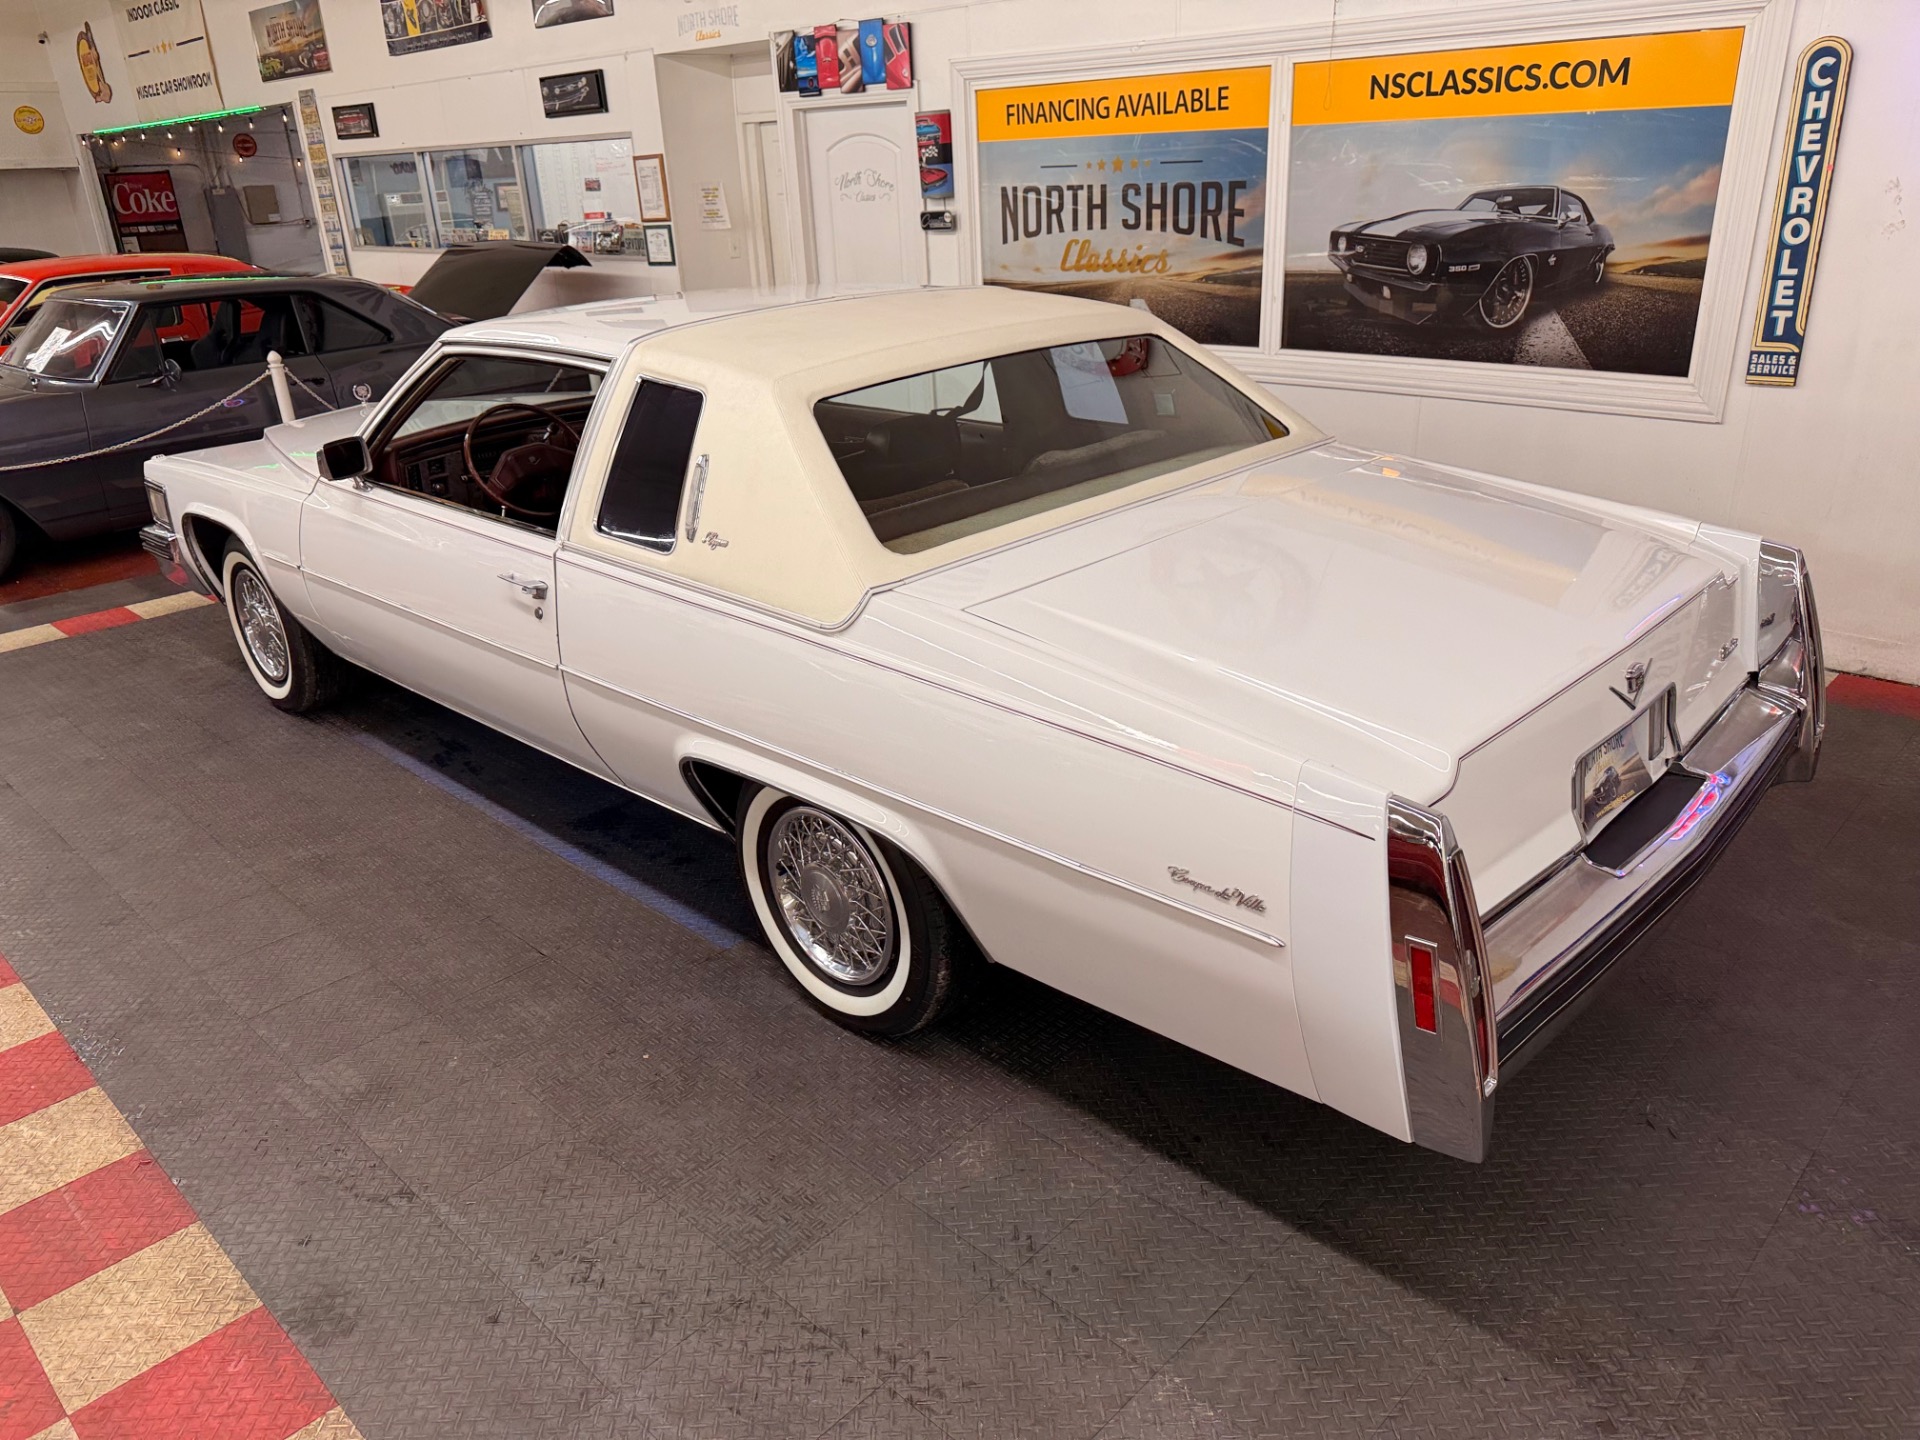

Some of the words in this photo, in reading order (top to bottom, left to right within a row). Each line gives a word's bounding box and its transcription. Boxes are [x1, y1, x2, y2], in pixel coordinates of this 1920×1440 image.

[126, 4, 153, 22] INDOOR
[677, 10, 706, 37] NORTH
[707, 5, 740, 27] SHORE
[136, 82, 160, 100] MUSCLE
[160, 77, 174, 95] CAR
[172, 71, 213, 92] SHOWROOM
[1369, 56, 1631, 100] NSCLASSICS.COM
[1005, 96, 1110, 126] FINANCING
[1115, 85, 1230, 118] AVAILABLE
[112, 182, 177, 215] Coke
[1770, 55, 1837, 336] CHEVROLET
[1000, 183, 1107, 245] NORTH
[1121, 180, 1247, 247] SHORE
[1060, 238, 1171, 274] Classics
[1749, 363, 1796, 375] SERVICE
[1751, 353, 1786, 365] SALES
[1788, 355, 1797, 365] &
